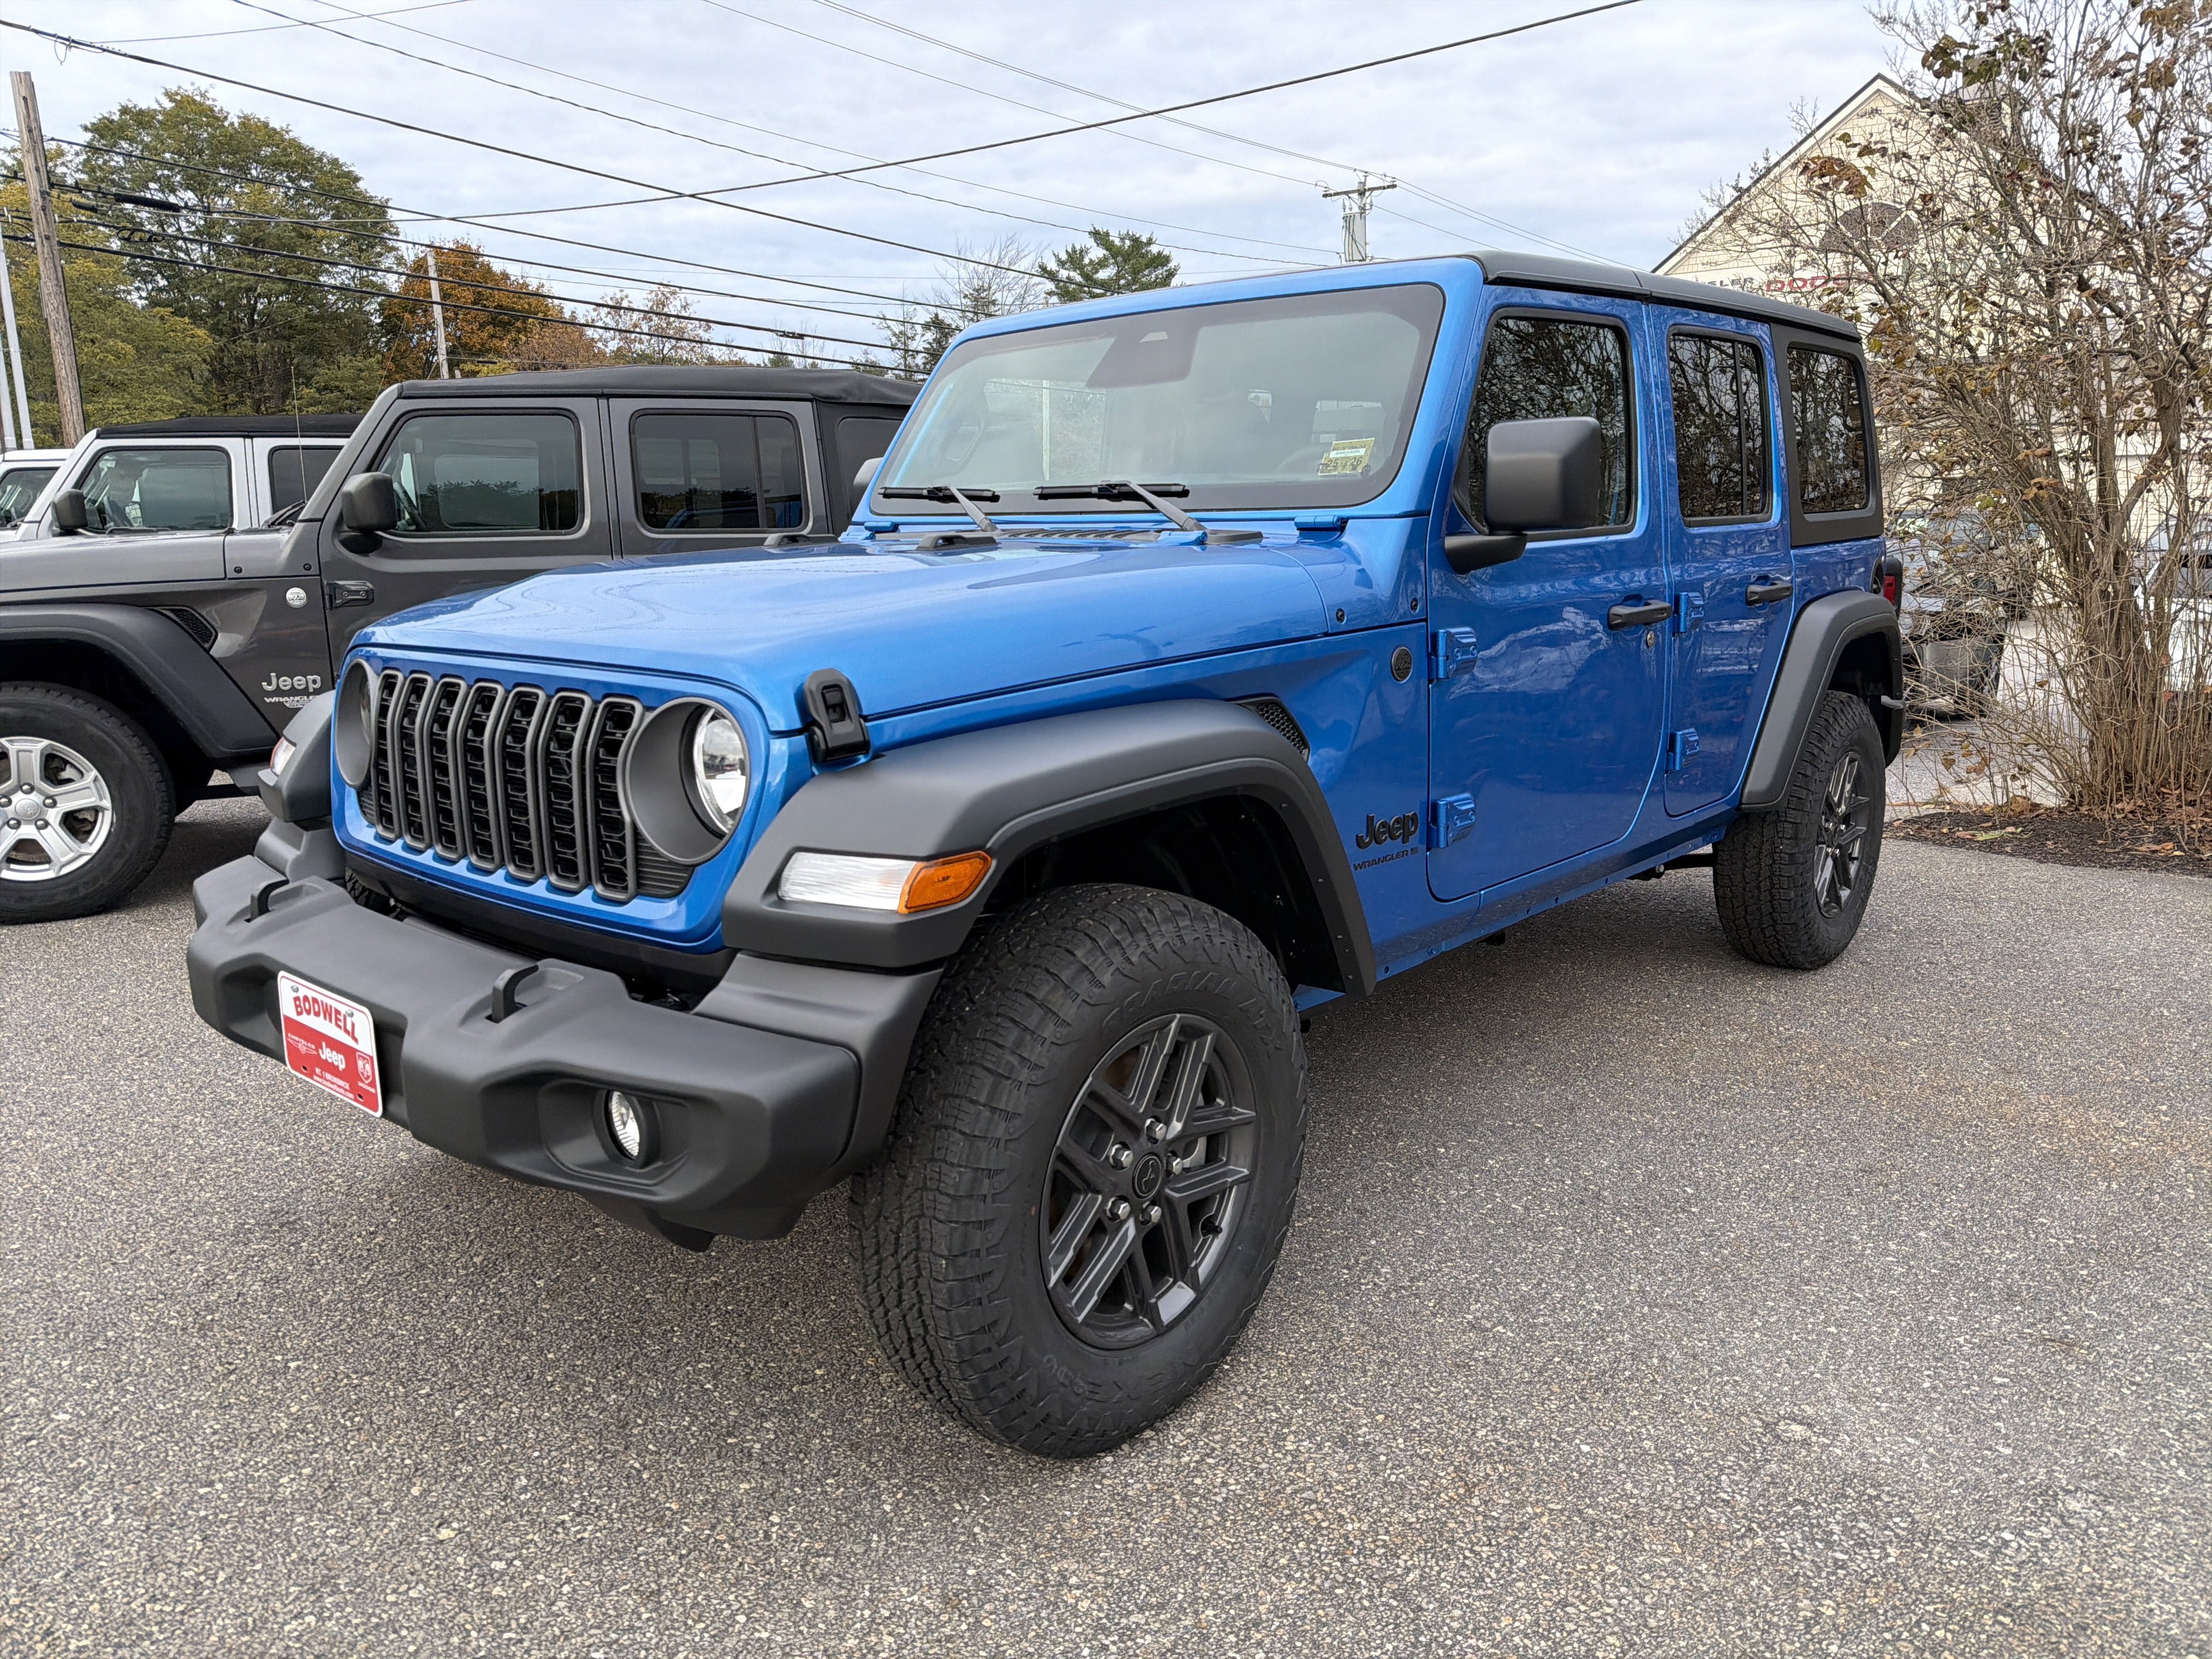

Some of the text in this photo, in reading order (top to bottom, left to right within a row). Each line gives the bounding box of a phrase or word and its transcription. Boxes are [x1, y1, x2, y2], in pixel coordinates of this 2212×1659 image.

[261, 673, 321, 692] Jeep
[1356, 811, 1419, 849] Jeep
[1353, 850, 1409, 871] WRANGLER
[293, 995, 359, 1046] BODWELL
[319, 1041, 346, 1071] Jeep
